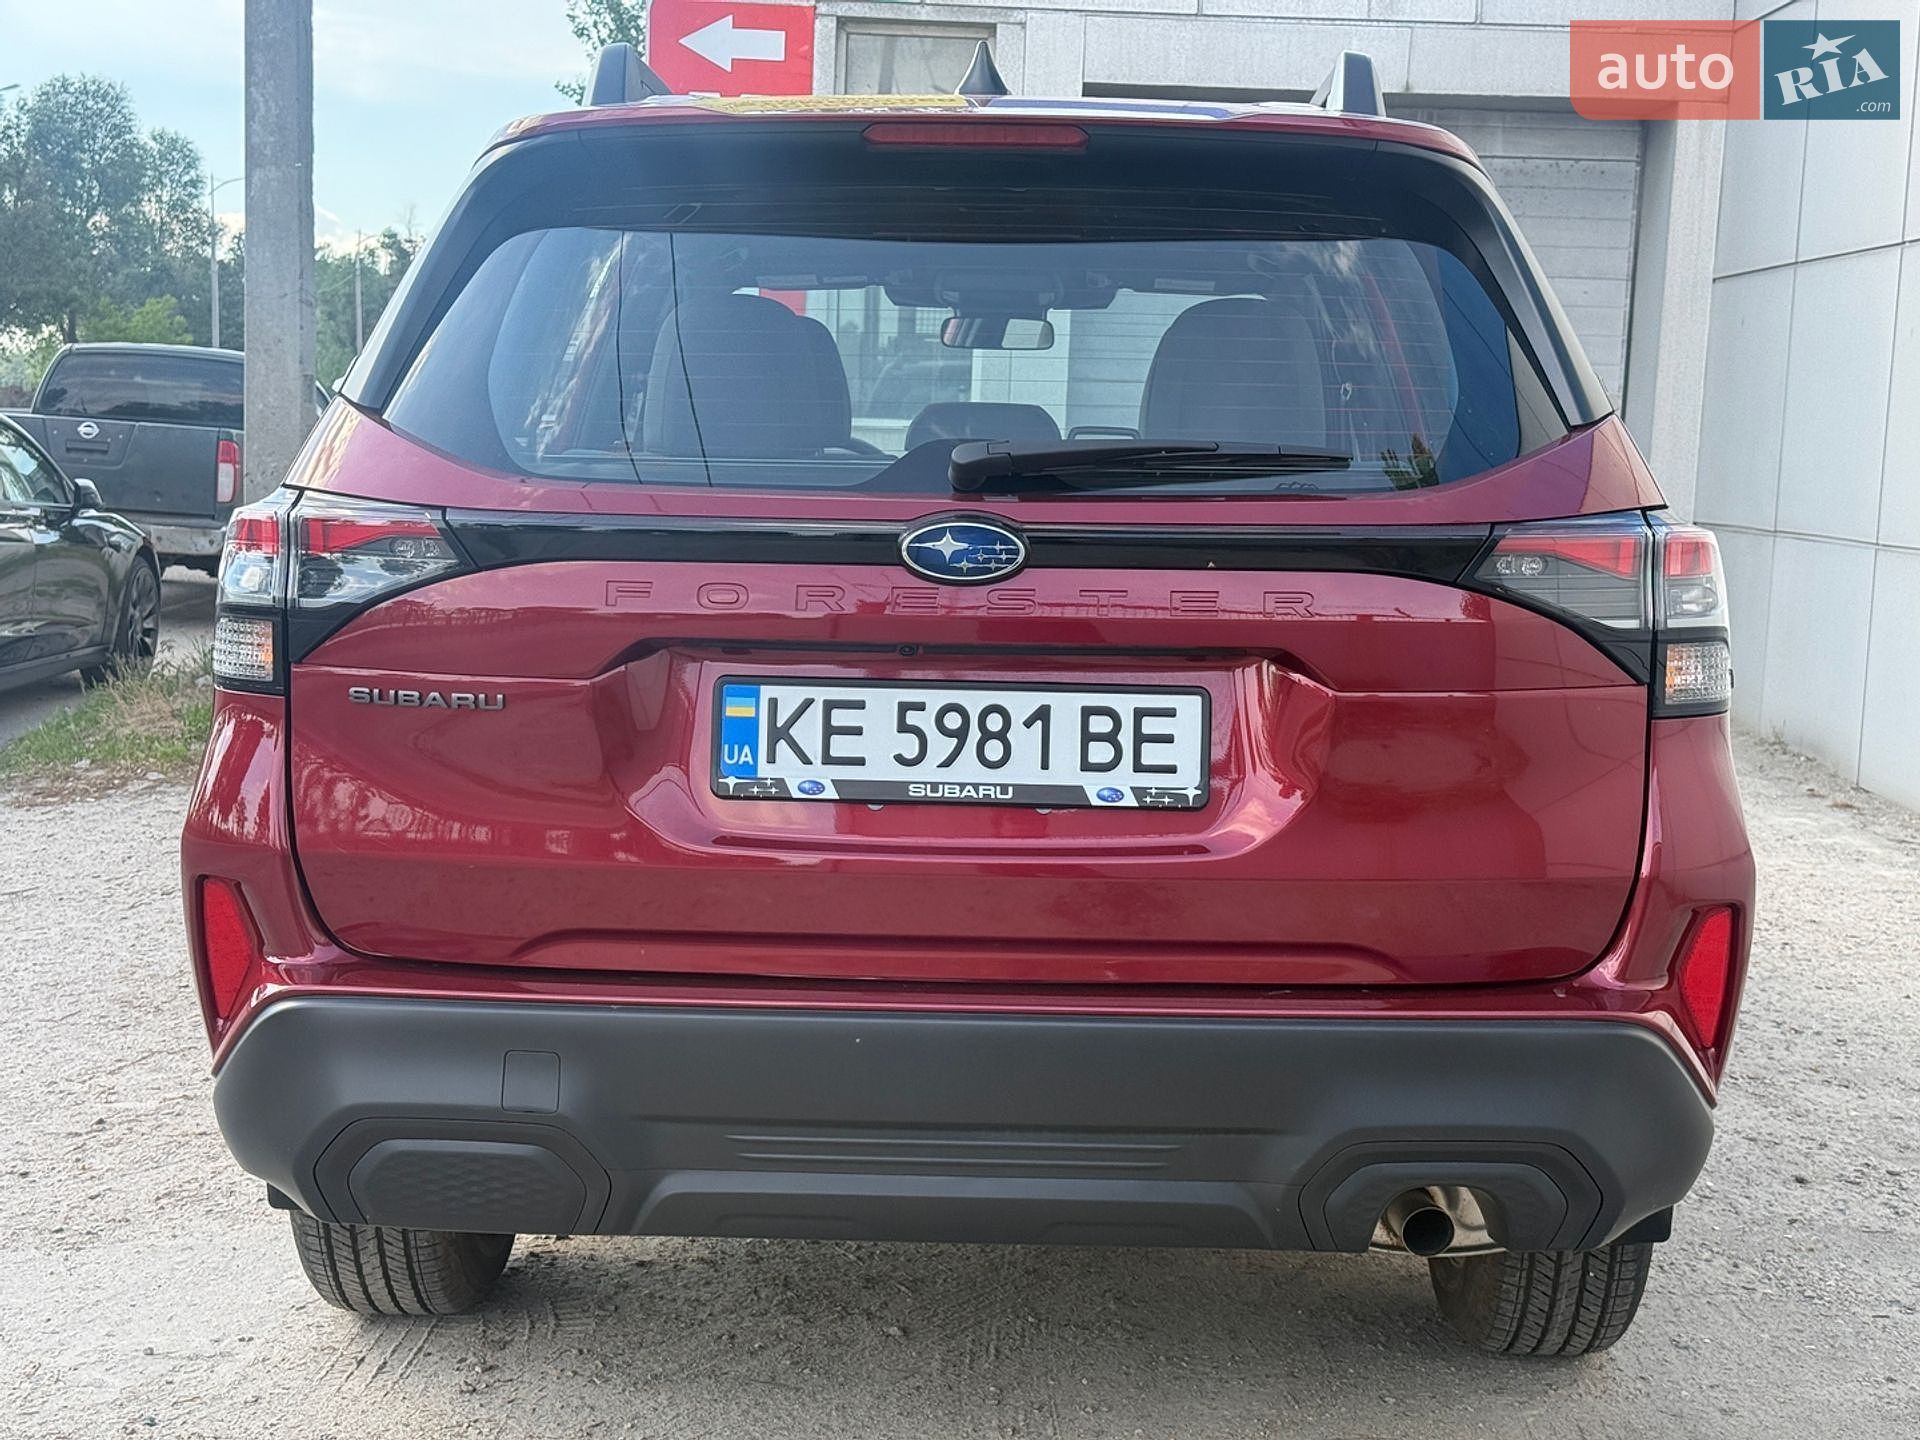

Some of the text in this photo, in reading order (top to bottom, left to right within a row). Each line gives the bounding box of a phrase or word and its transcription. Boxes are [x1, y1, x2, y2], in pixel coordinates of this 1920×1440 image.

[604, 579, 1318, 619] FORESTER
[347, 686, 506, 711] SUBARU
[765, 696, 1178, 775] KE 5981 BE
[723, 743, 754, 767] UA
[907, 782, 1015, 800] SUBARU
